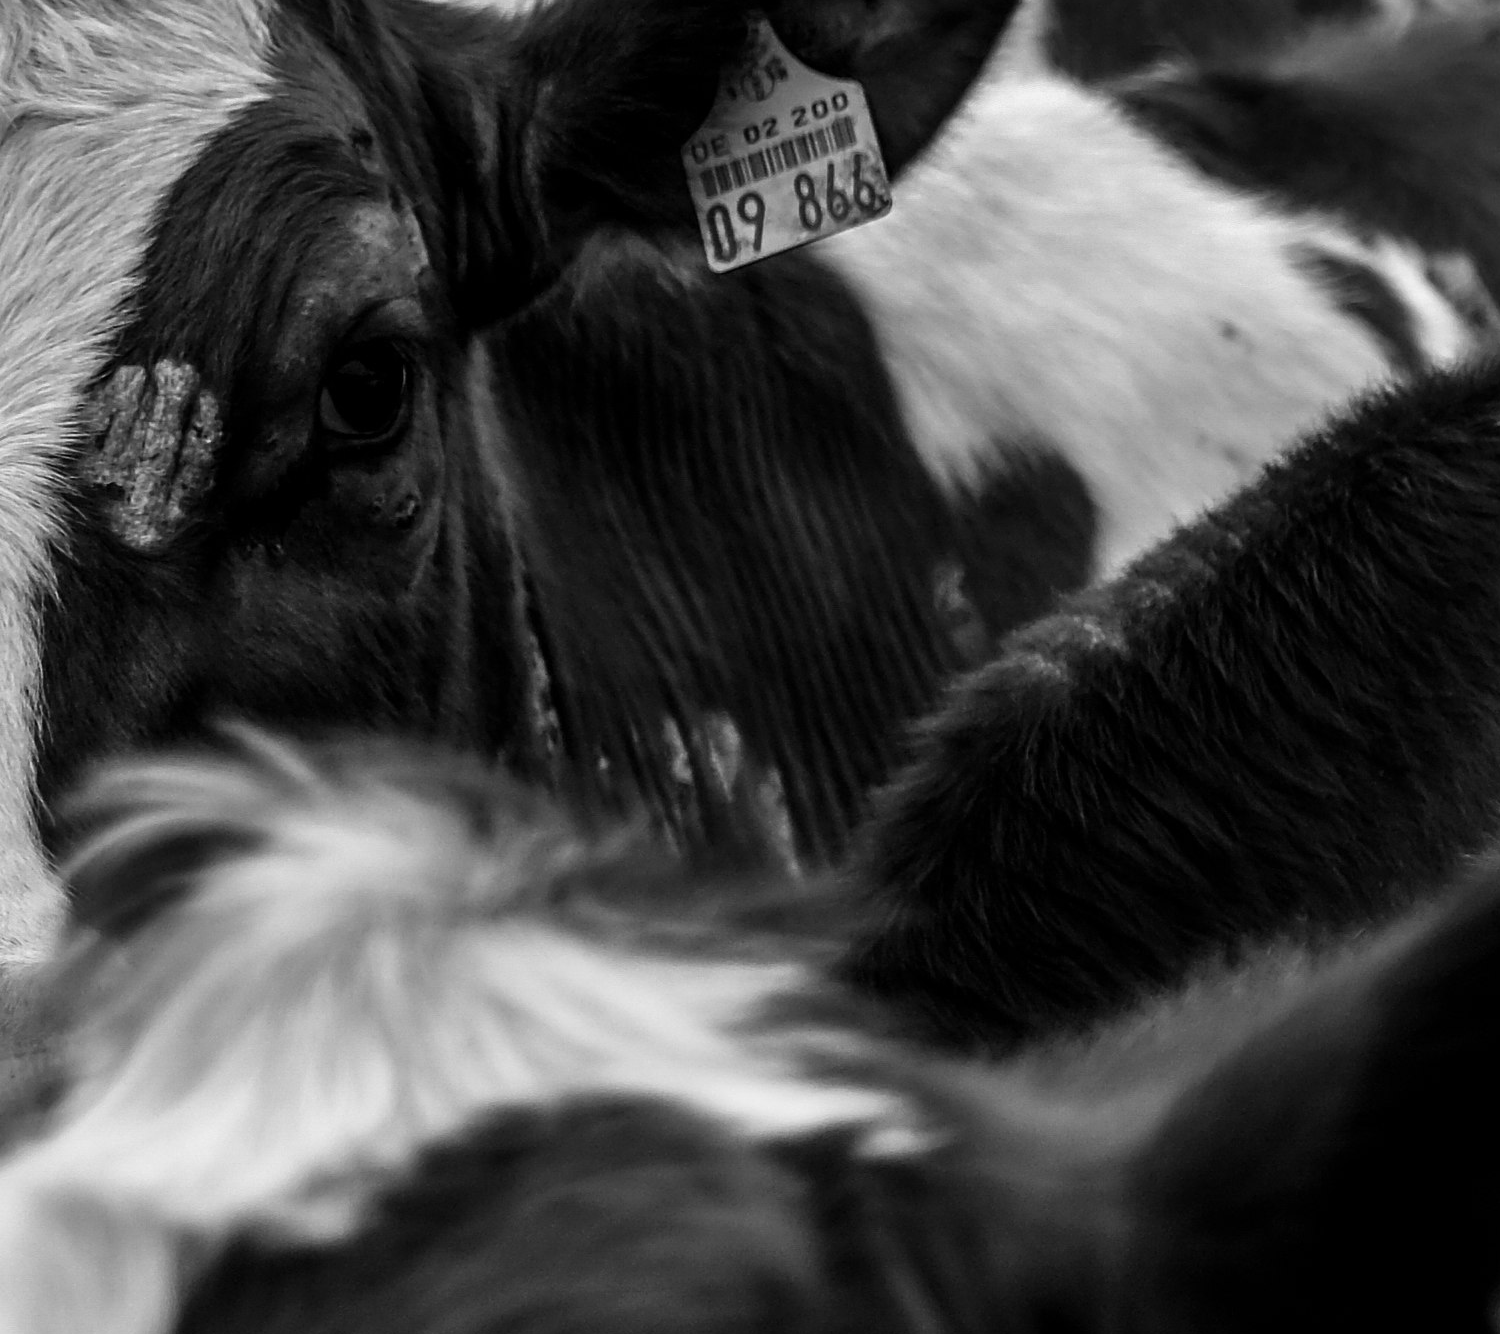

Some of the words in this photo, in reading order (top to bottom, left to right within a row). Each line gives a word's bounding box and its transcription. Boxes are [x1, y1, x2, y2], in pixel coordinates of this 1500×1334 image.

[743, 117, 780, 146] 02
[791, 91, 849, 128] 200
[706, 191, 766, 263] 09
[794, 152, 877, 231] 866
